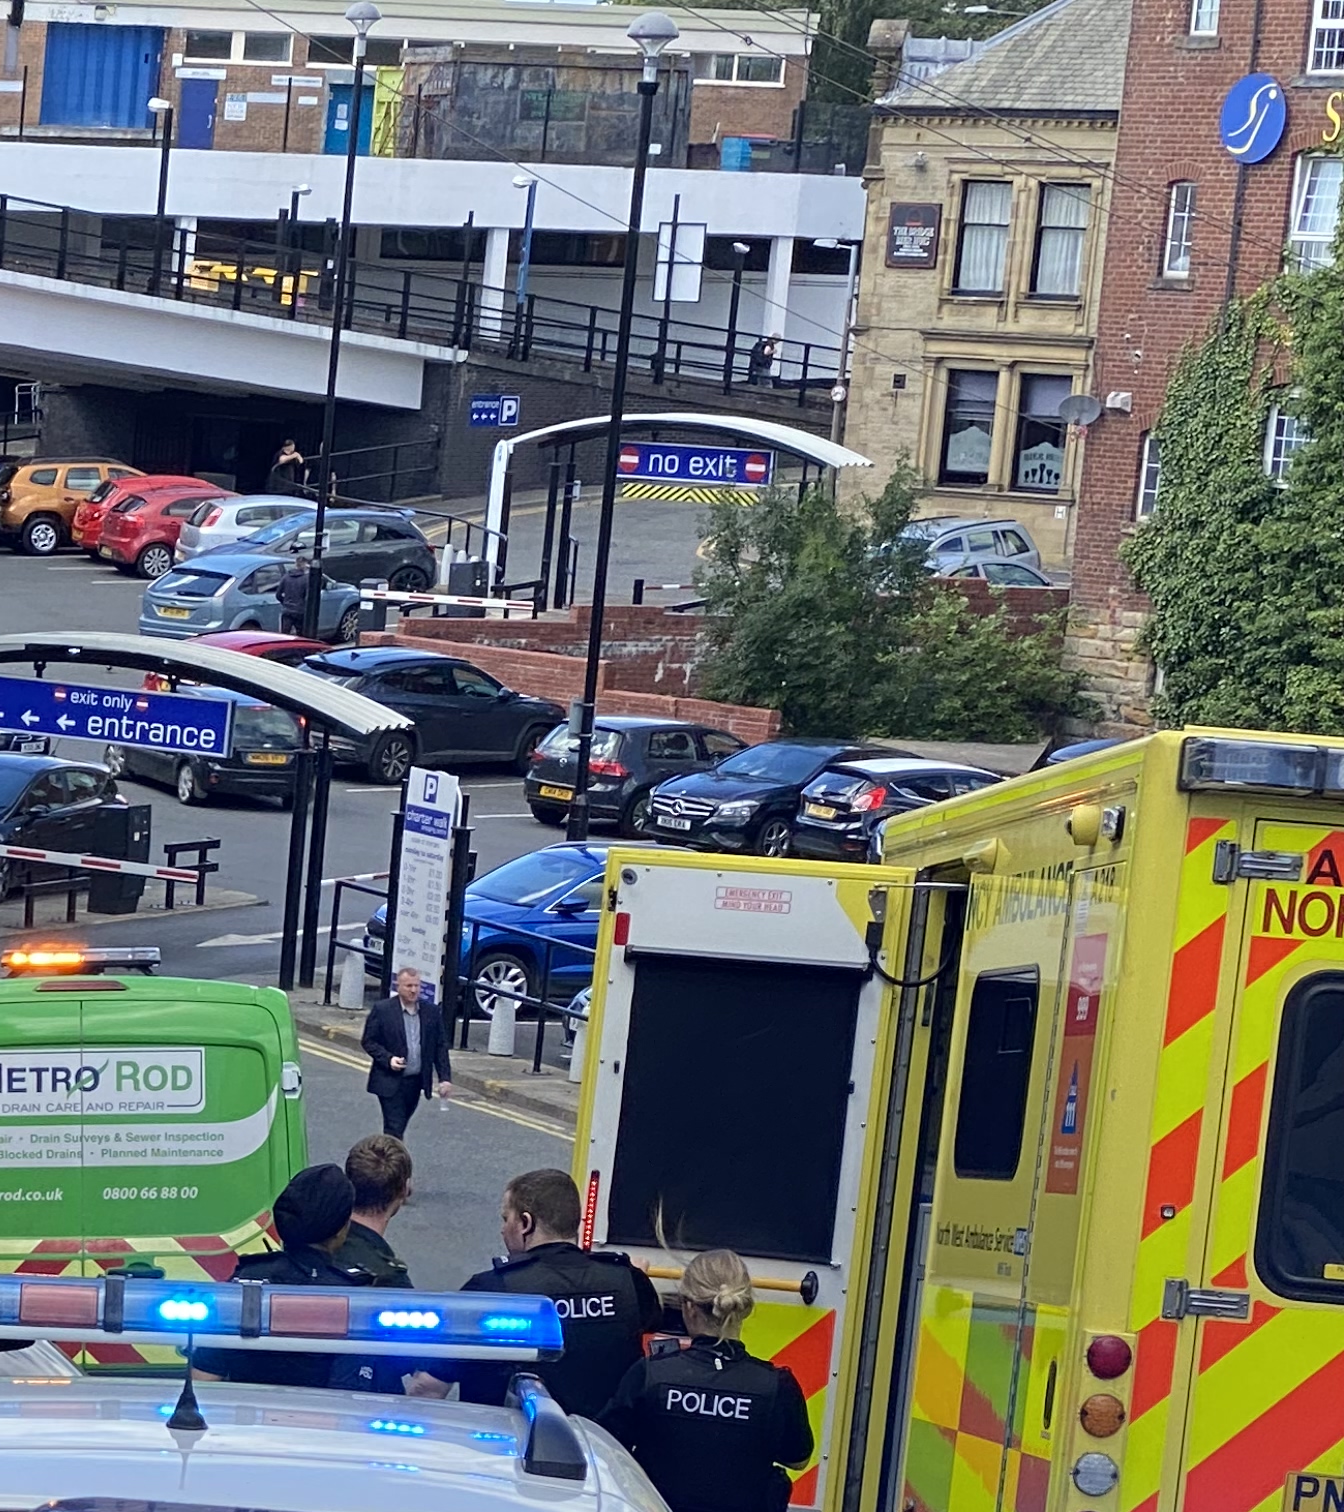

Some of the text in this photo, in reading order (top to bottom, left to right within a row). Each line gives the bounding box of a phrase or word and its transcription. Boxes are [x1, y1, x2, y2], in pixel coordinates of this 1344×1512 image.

[502, 400, 517, 422] P
[648, 453, 738, 479] no exit
[70, 689, 133, 713] exit only
[86, 714, 217, 749] entrance
[425, 777, 437, 800] P
[115, 1060, 193, 1092] ROD
[1, 1101, 165, 1114] DRAIN CARE AND REPAIR
[30, 1133, 60, 1144] Drain
[64, 1132, 111, 1145] Surveys
[113, 1132, 122, 1143] &
[125, 1132, 161, 1142] Sewer
[164, 1131, 225, 1144] Inspection
[46, 1149, 83, 1159] Drains
[101, 1148, 148, 1158] Planned
[150, 1147, 224, 1157] Maintenance
[103, 1186, 138, 1200] 0800
[140, 1186, 158, 1199] 66
[160, 1186, 178, 1199] 88
[180, 1186, 199, 1199] 00
[555, 1296, 616, 1318] OLICE
[666, 1389, 752, 1420] POLICE
